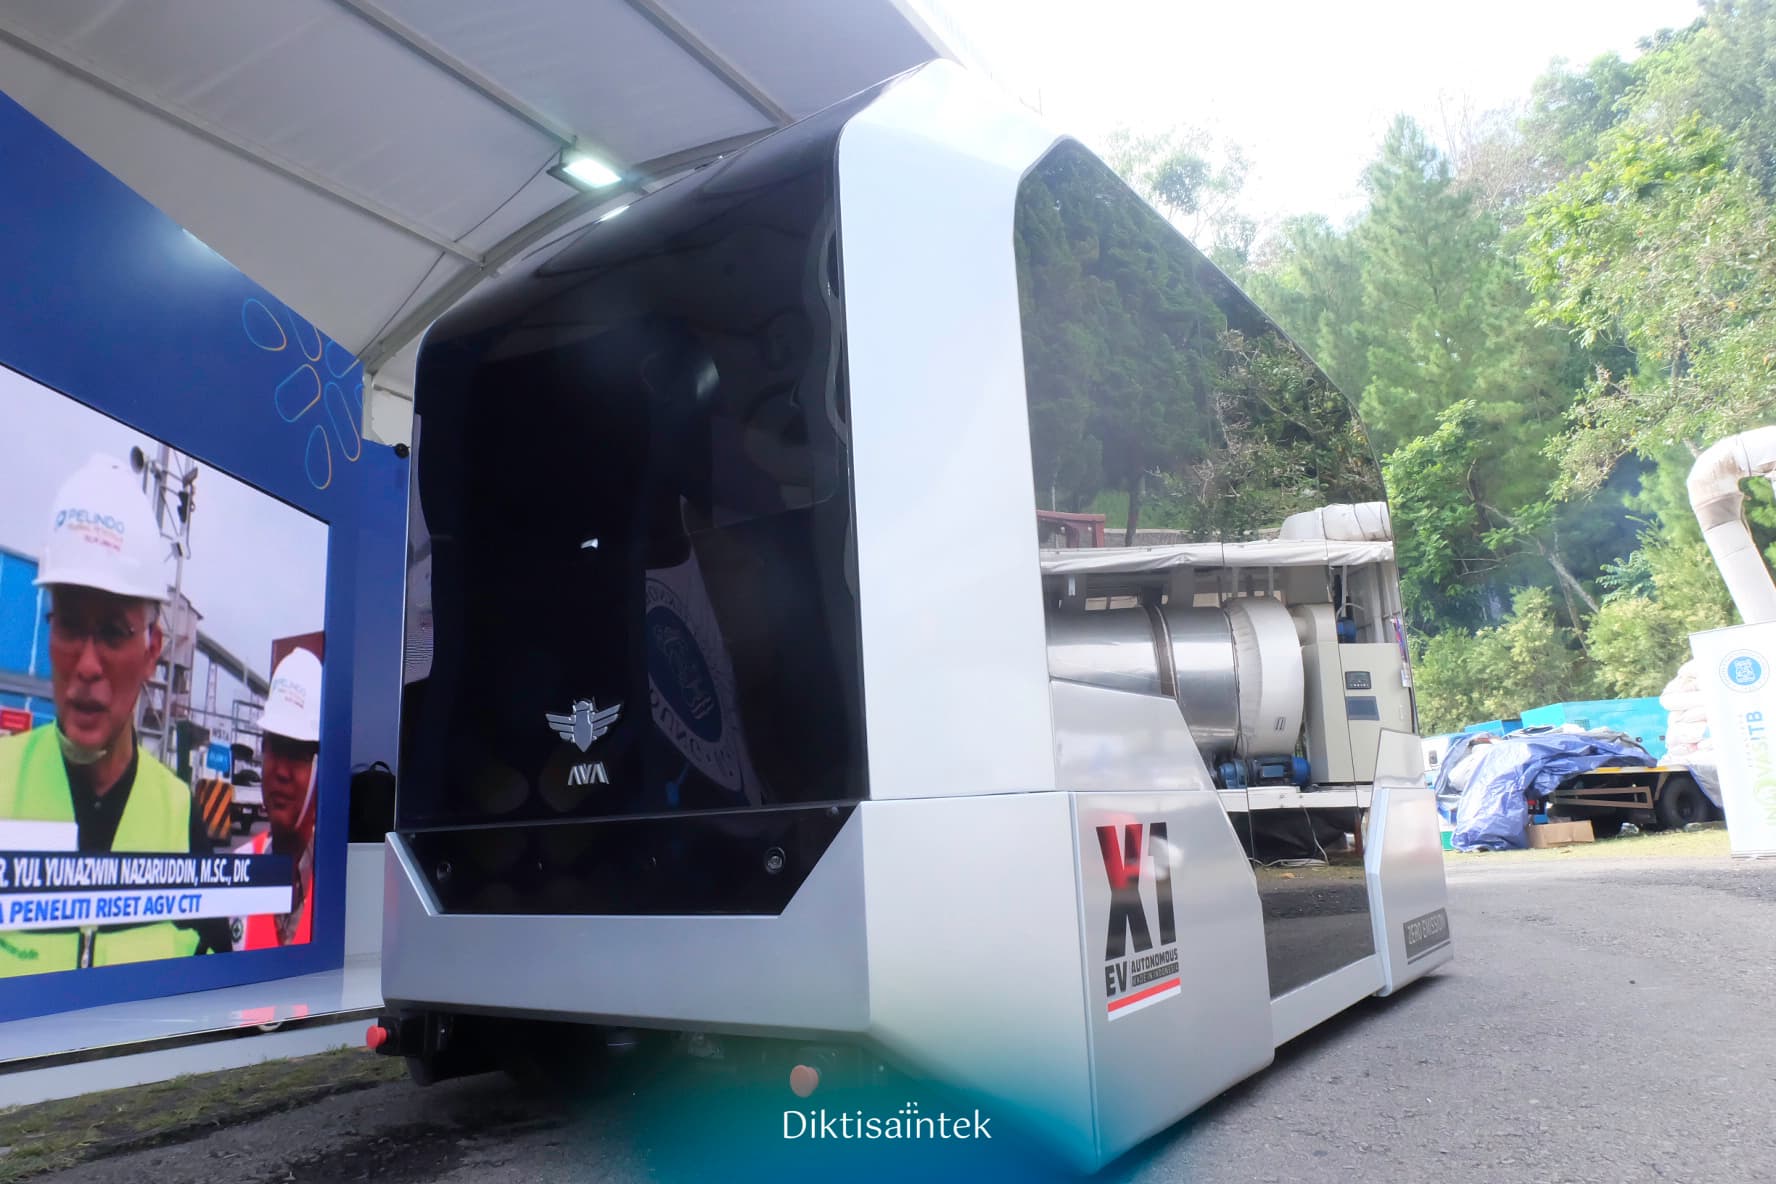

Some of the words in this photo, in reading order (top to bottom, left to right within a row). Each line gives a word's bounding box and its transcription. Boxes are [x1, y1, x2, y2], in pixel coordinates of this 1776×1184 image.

[68, 508, 125, 534] PELINDO
[13, 857, 41, 887] YUL
[45, 857, 118, 886] YUNAZWIN
[120, 858, 198, 886] NAZARUDDIN,
[233, 858, 250, 882] DIC
[10, 898, 91, 923] PENELITI
[96, 896, 141, 918] RISET
[143, 895, 176, 916] AGV
[178, 894, 202, 913] CTT
[1105, 960, 1127, 997] EV
[1131, 948, 1178, 974] AUTONOMOUS
